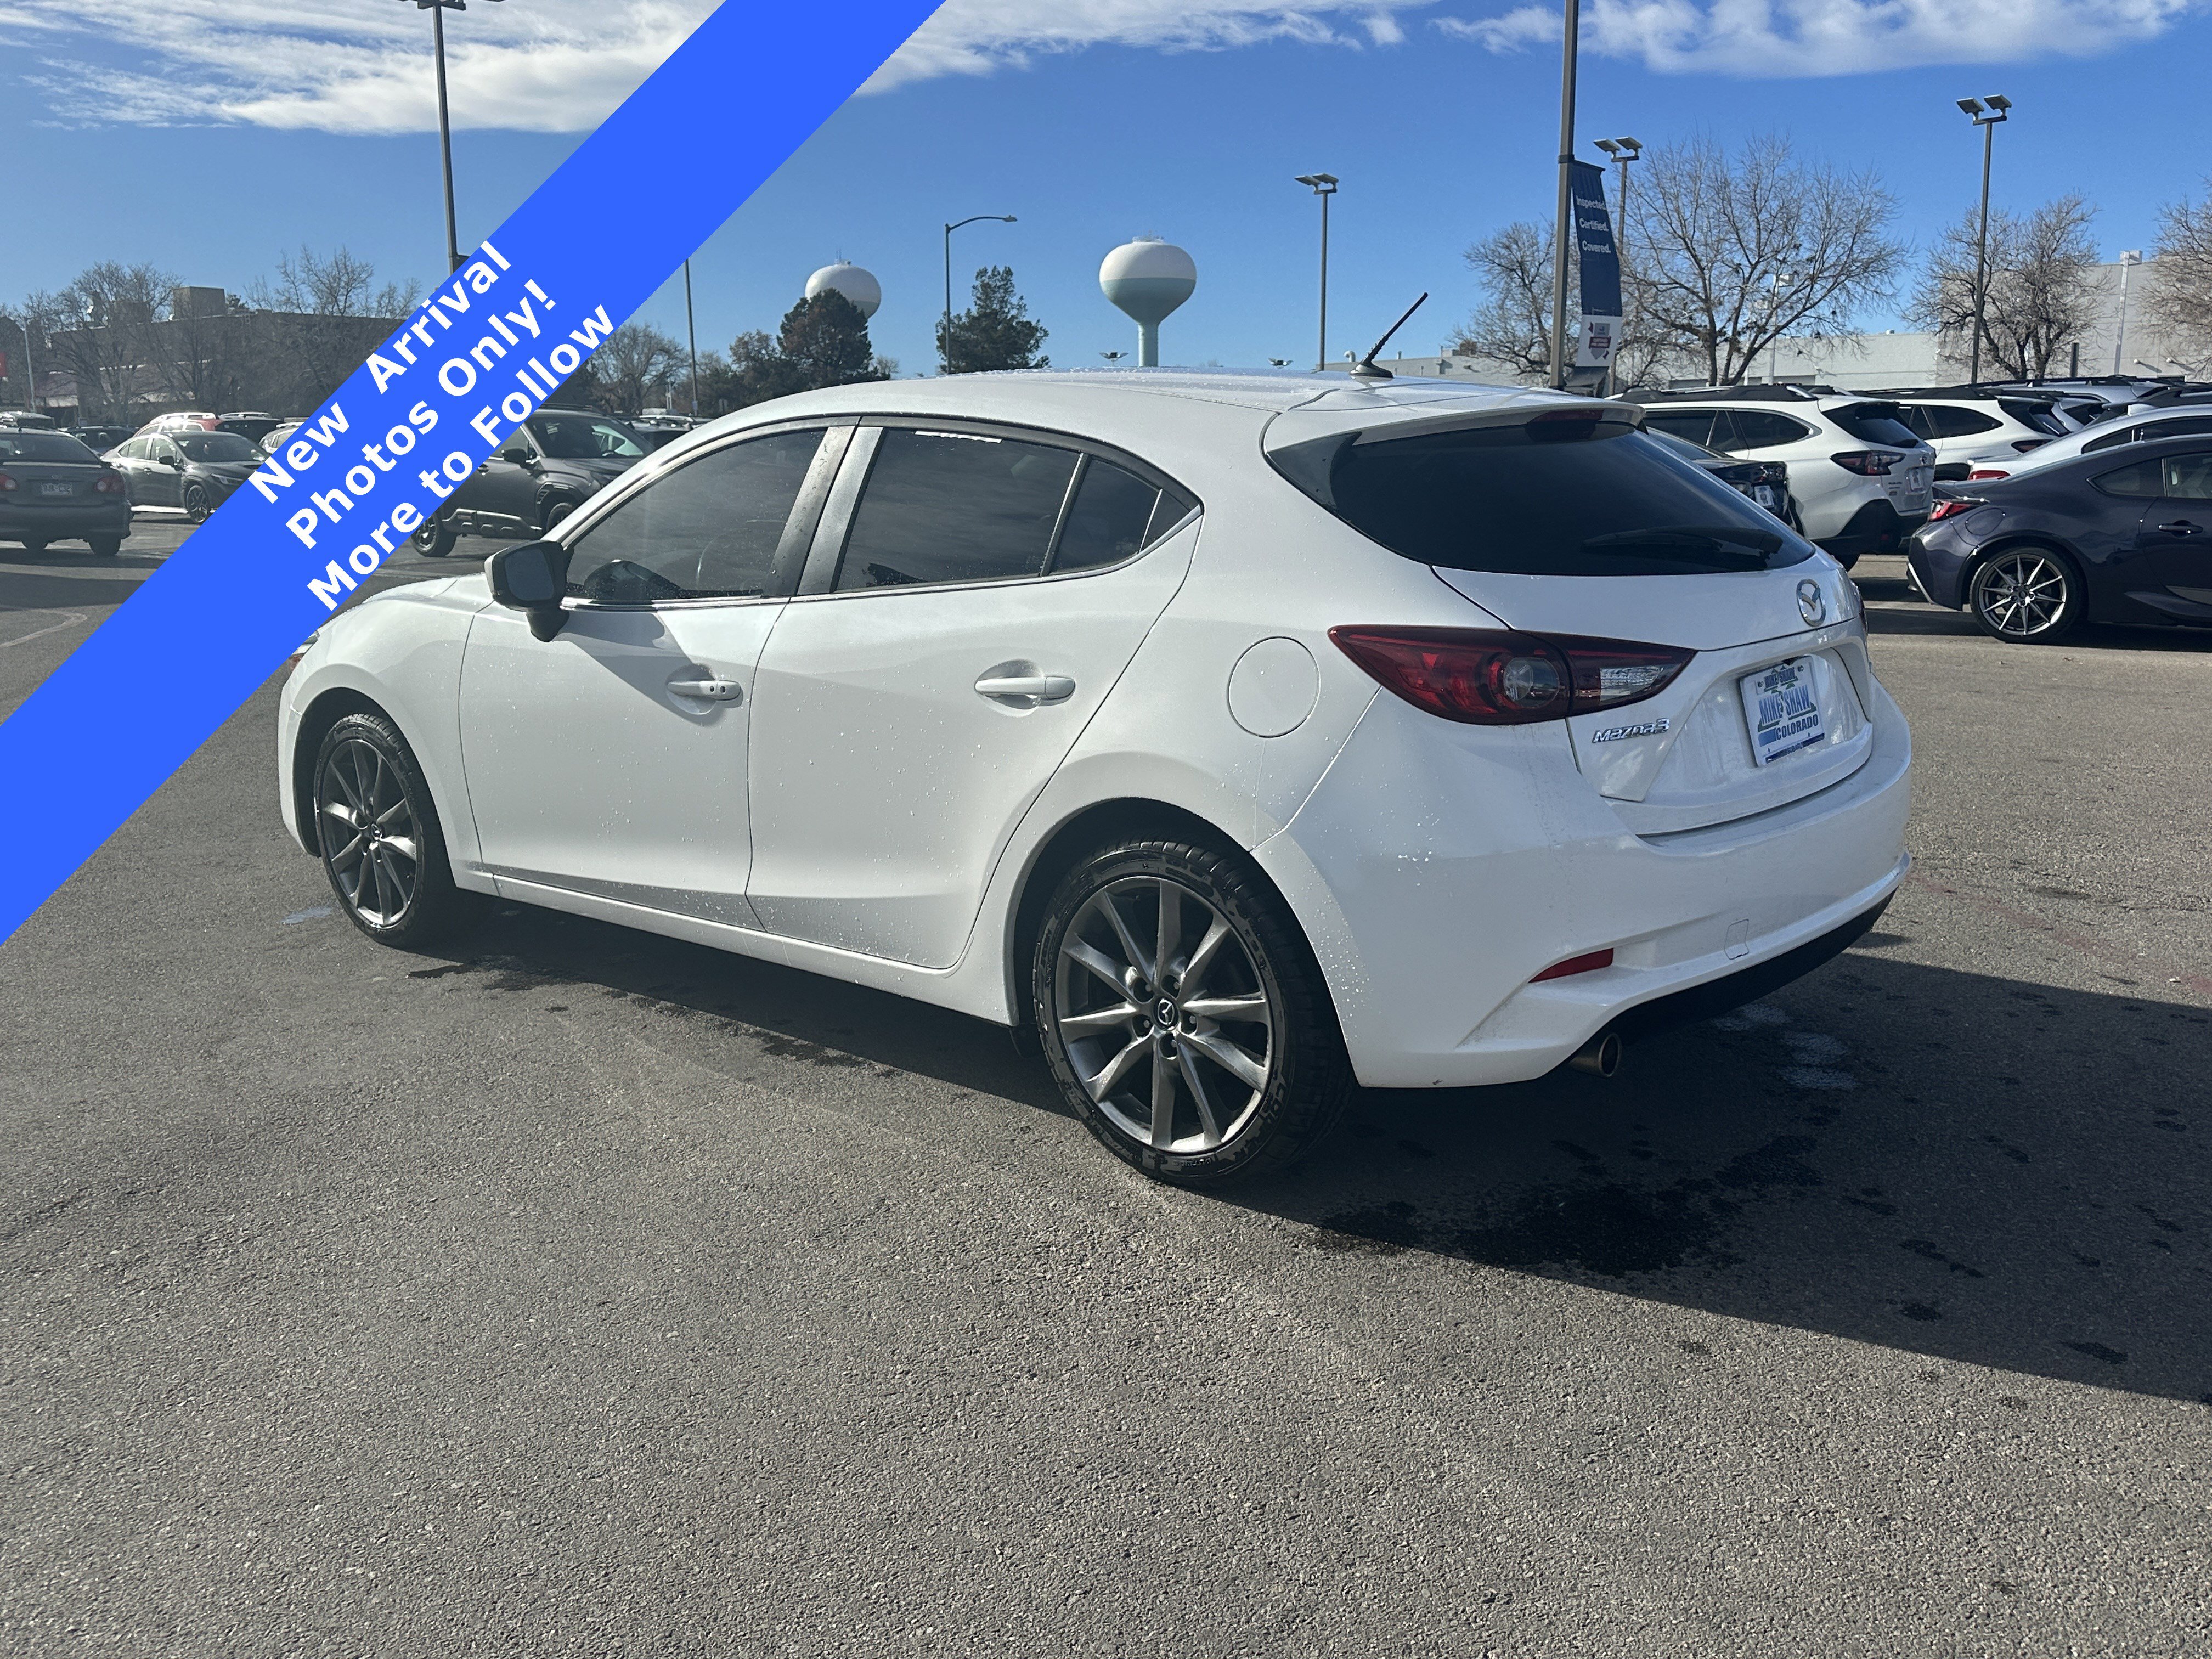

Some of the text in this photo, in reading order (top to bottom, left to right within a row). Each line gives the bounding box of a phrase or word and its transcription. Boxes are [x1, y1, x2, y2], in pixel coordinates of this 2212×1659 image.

[1579, 218, 1609, 232] Certified.
[1582, 240, 1611, 253] Covered.
[1764, 667, 1796, 689] MIKE SHAW
[1759, 684, 1811, 725] MIKE SHAW
[1776, 714, 1819, 740] COLORADO
